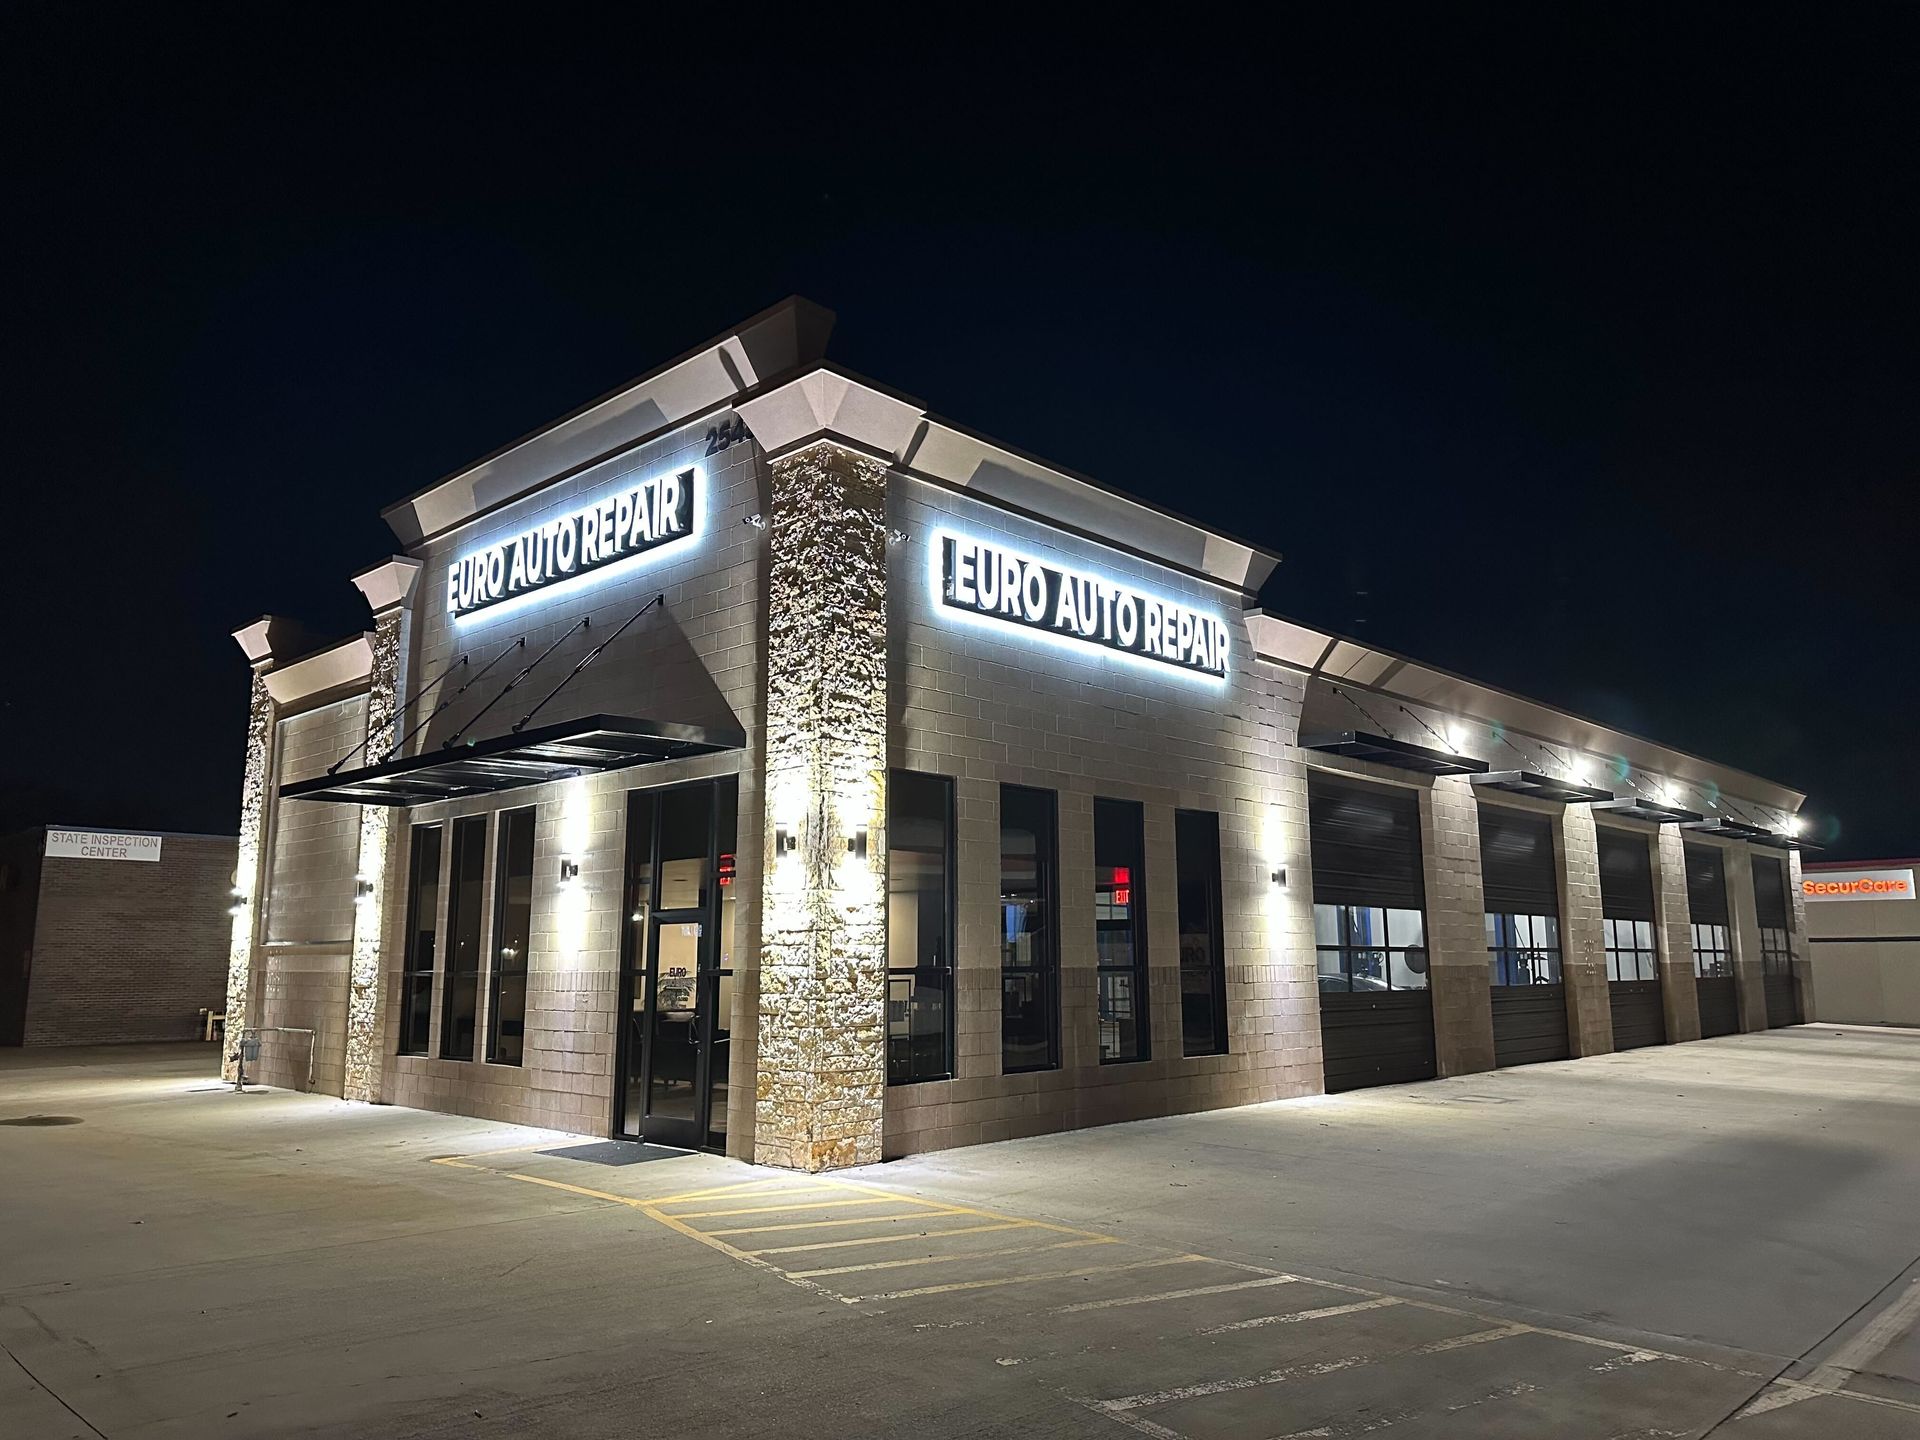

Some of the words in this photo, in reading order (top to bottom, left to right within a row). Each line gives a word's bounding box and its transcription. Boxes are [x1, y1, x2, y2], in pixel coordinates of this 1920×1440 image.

[447, 544, 505, 612] EURO
[509, 517, 577, 590] AUTO
[581, 473, 682, 565] REPAIR
[955, 545, 1047, 622] EURO
[1055, 571, 1138, 647] AUTO
[1145, 600, 1230, 673] REPAIR
[52, 832, 88, 844] STATE
[91, 834, 158, 848] INSPECTION
[81, 846, 127, 858] CENTER
[1803, 877, 1908, 895] SecurCare
[1115, 889, 1129, 904] EXIT
[669, 967, 687, 978] EURO
